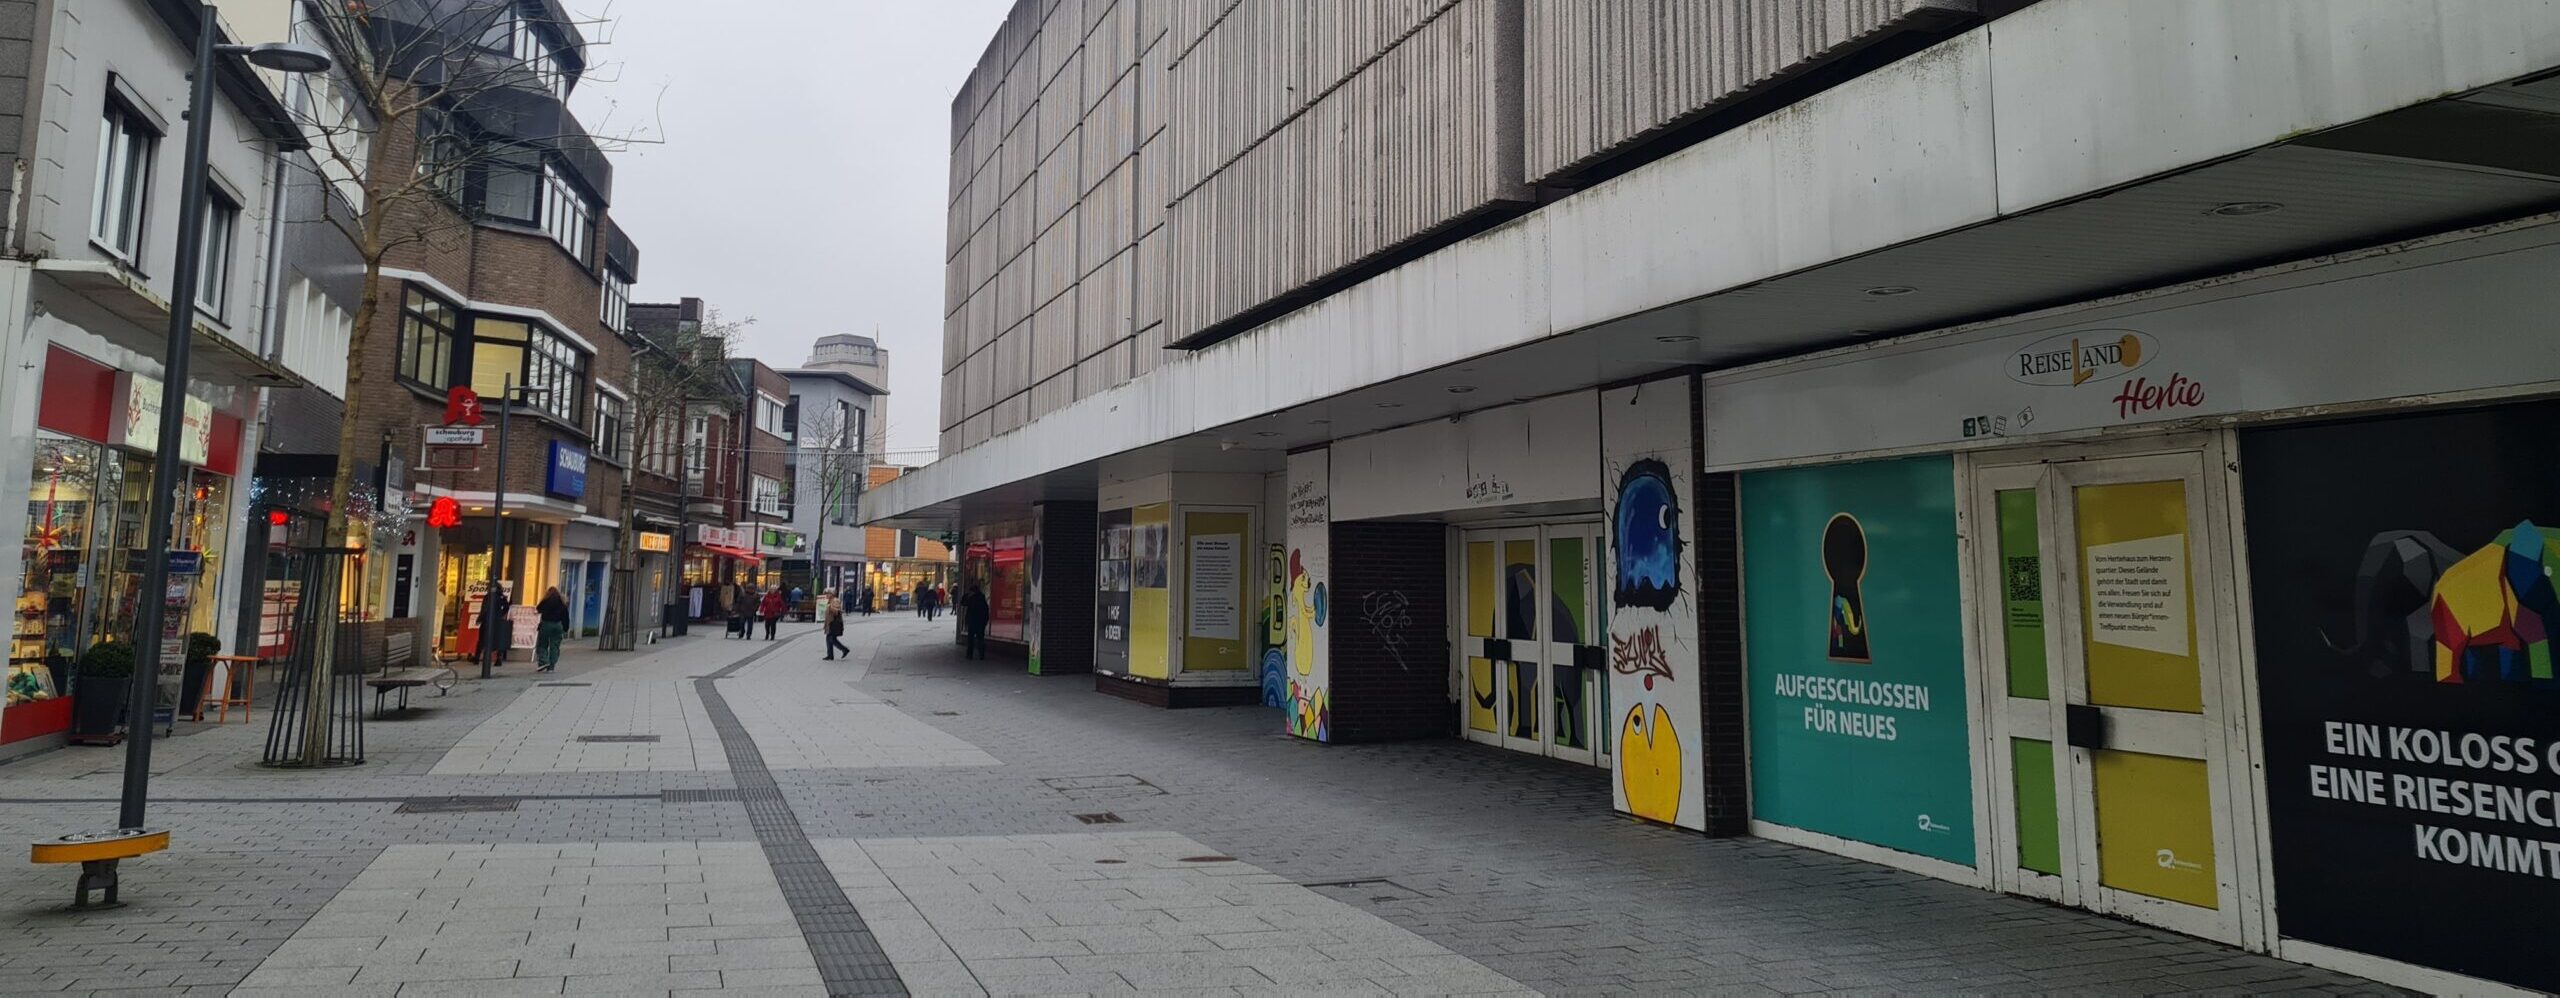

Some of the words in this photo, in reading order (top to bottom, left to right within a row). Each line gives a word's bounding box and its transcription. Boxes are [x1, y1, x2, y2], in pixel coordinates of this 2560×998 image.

[2113, 371, 2205, 420] Hertie
[559, 447, 586, 474] SCHAUBURG
[2118, 566, 2135, 574] Dieses
[2136, 566, 2159, 574] Gelände
[2097, 577, 2114, 586] gehört
[2124, 577, 2139, 585] Stadt
[2122, 589, 2141, 597] Freuen
[2141, 589, 2149, 597] Sie
[2150, 589, 2161, 597] sich
[2162, 589, 2171, 597] auf
[1111, 604, 1120, 620] HOF
[2098, 600, 2107, 608] die
[2107, 600, 2142, 610] Verwandlung
[2154, 601, 2164, 609] auf
[1109, 625, 1121, 640] IDEEN
[2098, 622, 2126, 632] Treffpunkt
[1775, 673, 1930, 711] AUFGESCHLOSSEN
[1804, 706, 1837, 733] FÜR
[1839, 710, 1897, 741] NEUES
[2325, 721, 2381, 759] EIN
[2389, 727, 2538, 774] KOLOSS
[2310, 765, 2387, 806] EINE
[2415, 824, 2560, 880] KOMMT
